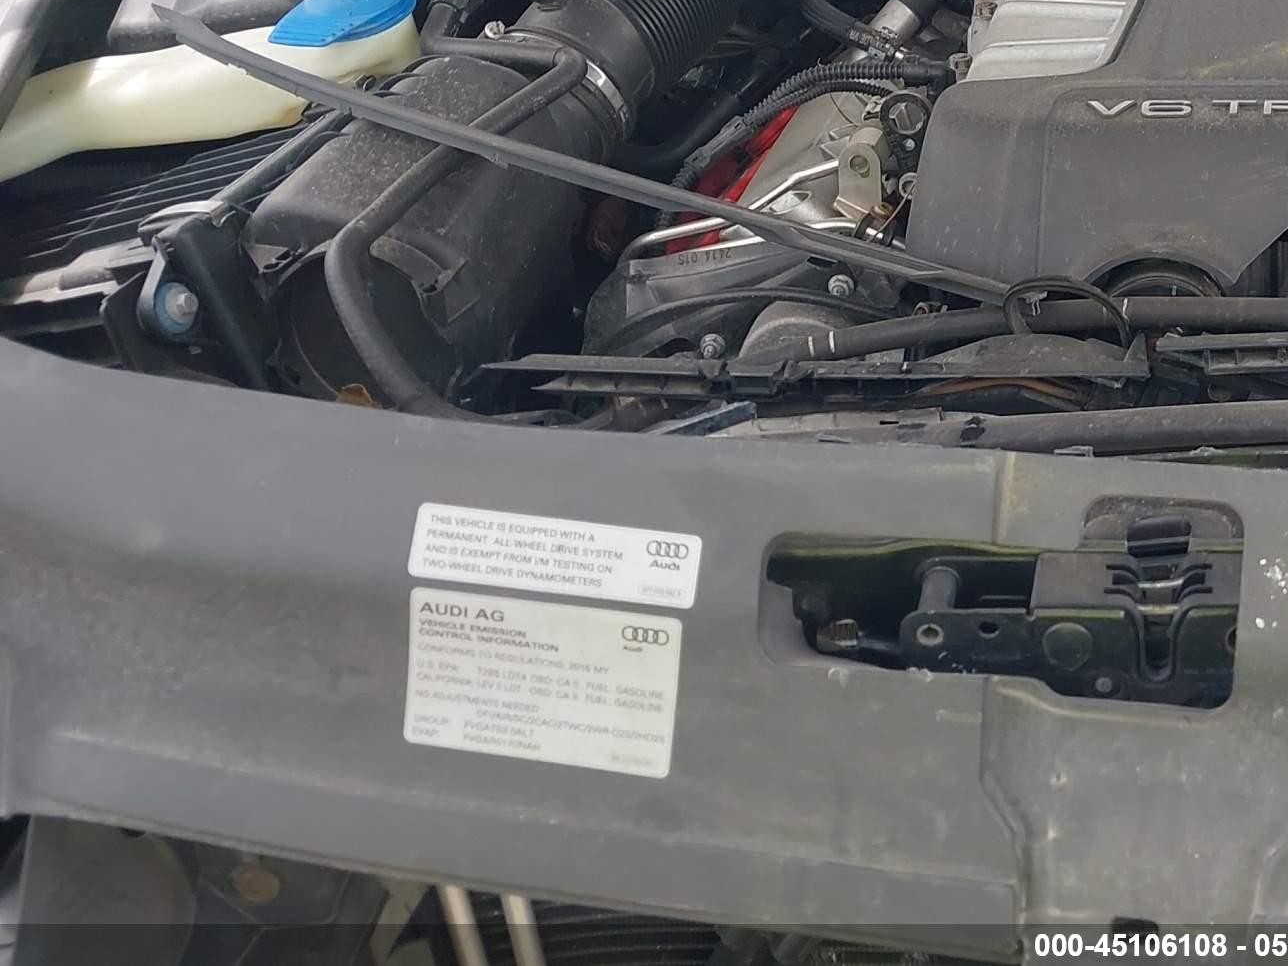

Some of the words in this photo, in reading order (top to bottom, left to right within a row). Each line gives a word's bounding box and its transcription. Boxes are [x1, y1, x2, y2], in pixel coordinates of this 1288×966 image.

[1087, 98, 1194, 119] V6
[430, 514, 452, 524] THIS
[454, 517, 493, 529] VEHICLE
[496, 522, 505, 531] IS
[508, 523, 557, 537] EQUIPPED
[559, 529, 584, 540] WITH
[588, 533, 595, 541] A
[426, 528, 488, 544] PERMANENT
[550, 543, 579, 555] DRIVE
[582, 547, 623, 560] SYSTEM
[424, 543, 447, 554] AND
[449, 546, 457, 555] IS
[460, 547, 501, 560] EXEMPT
[503, 552, 531, 563] FROM
[552, 558, 594, 571] TESTING
[596, 563, 612, 573] ON
[648, 558, 680, 571] Audi
[422, 558, 481, 573] TWO-WHEEL
[485, 565, 513, 577] DRIVE
[515, 569, 602, 587] DYNAMOMETERS
[419, 600, 468, 618] AUDI
[475, 607, 505, 623] AG
[419, 617, 465, 630] VEHICLE
[469, 624, 526, 638] EMISSION
[417, 642, 475, 658] CONFORMS
[479, 650, 492, 660] TO
[418, 627, 472, 642] CONTROL
[476, 634, 559, 653] INFORMATION
